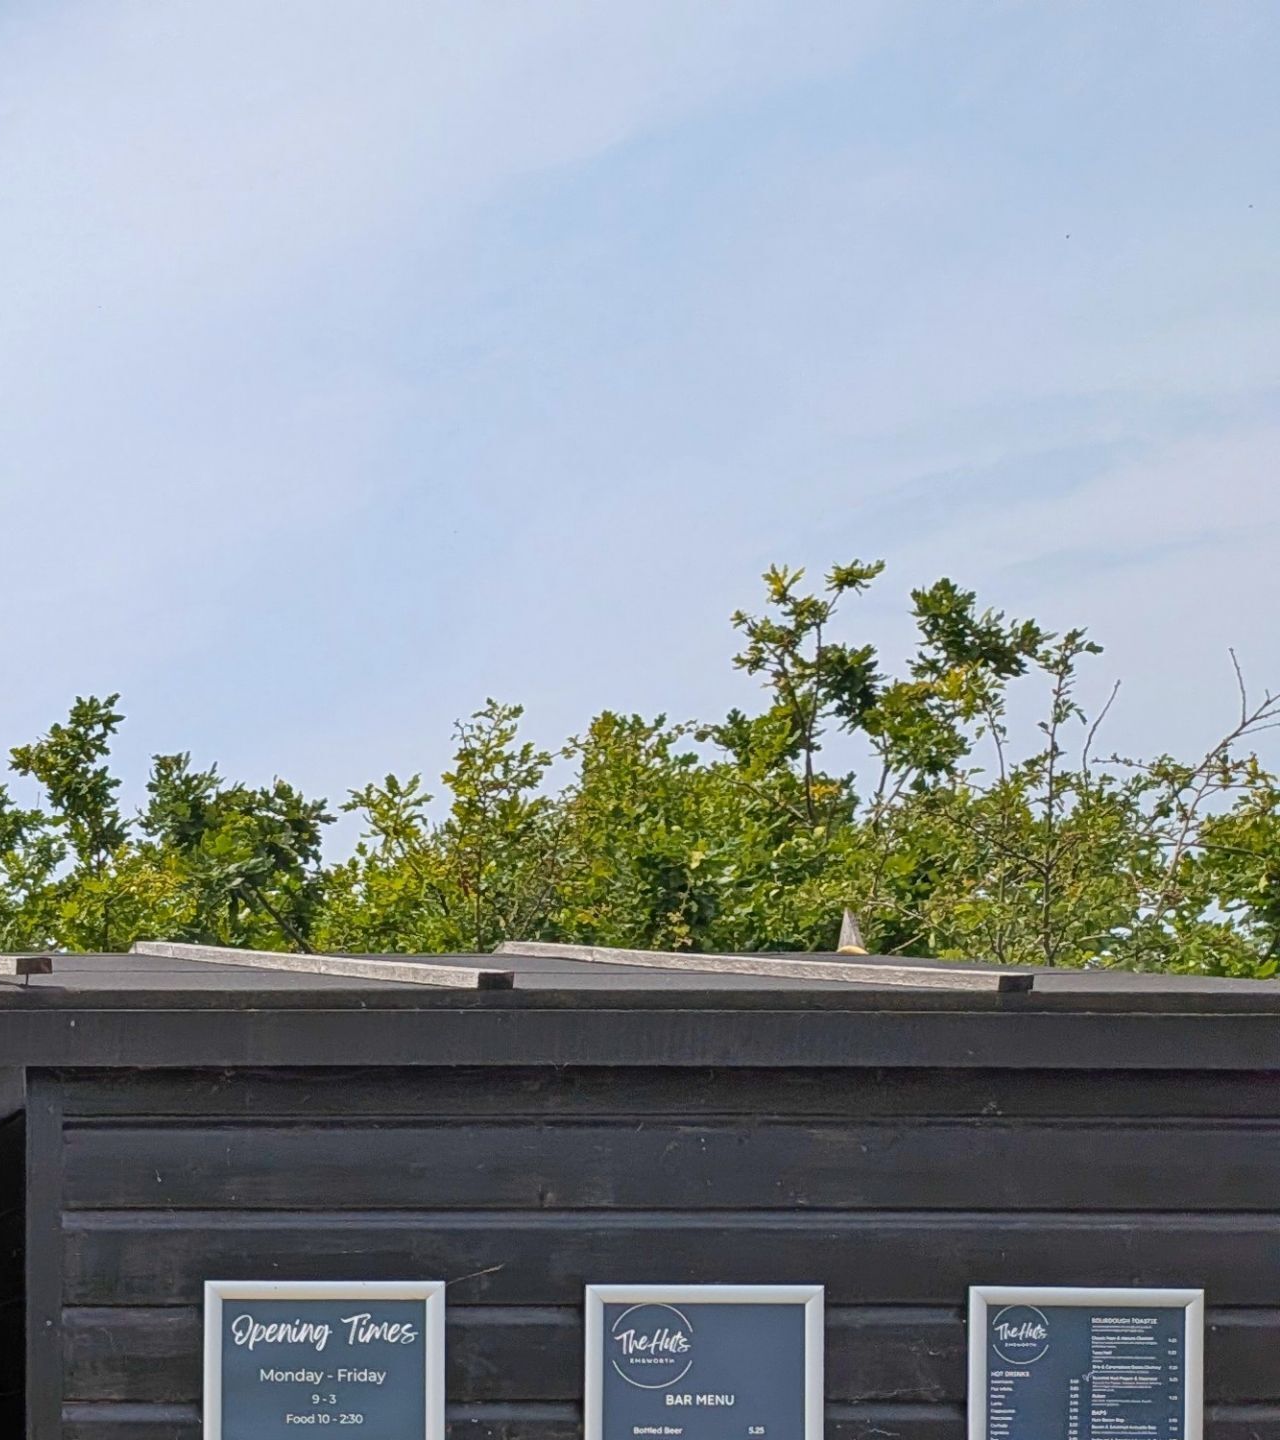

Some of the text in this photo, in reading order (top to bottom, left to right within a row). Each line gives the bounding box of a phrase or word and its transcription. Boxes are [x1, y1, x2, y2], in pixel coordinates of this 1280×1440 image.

[232, 1313, 418, 1351] Opening Times
[260, 1369, 324, 1384] Monday
[338, 1368, 386, 1384] Friday
[312, 1394, 320, 1404] 9
[329, 1394, 336, 1404] 3
[666, 1395, 734, 1405] BAR MENU
[287, 1414, 315, 1424] Food
[318, 1414, 330, 1424] 10
[340, 1414, 363, 1424] 2:30
